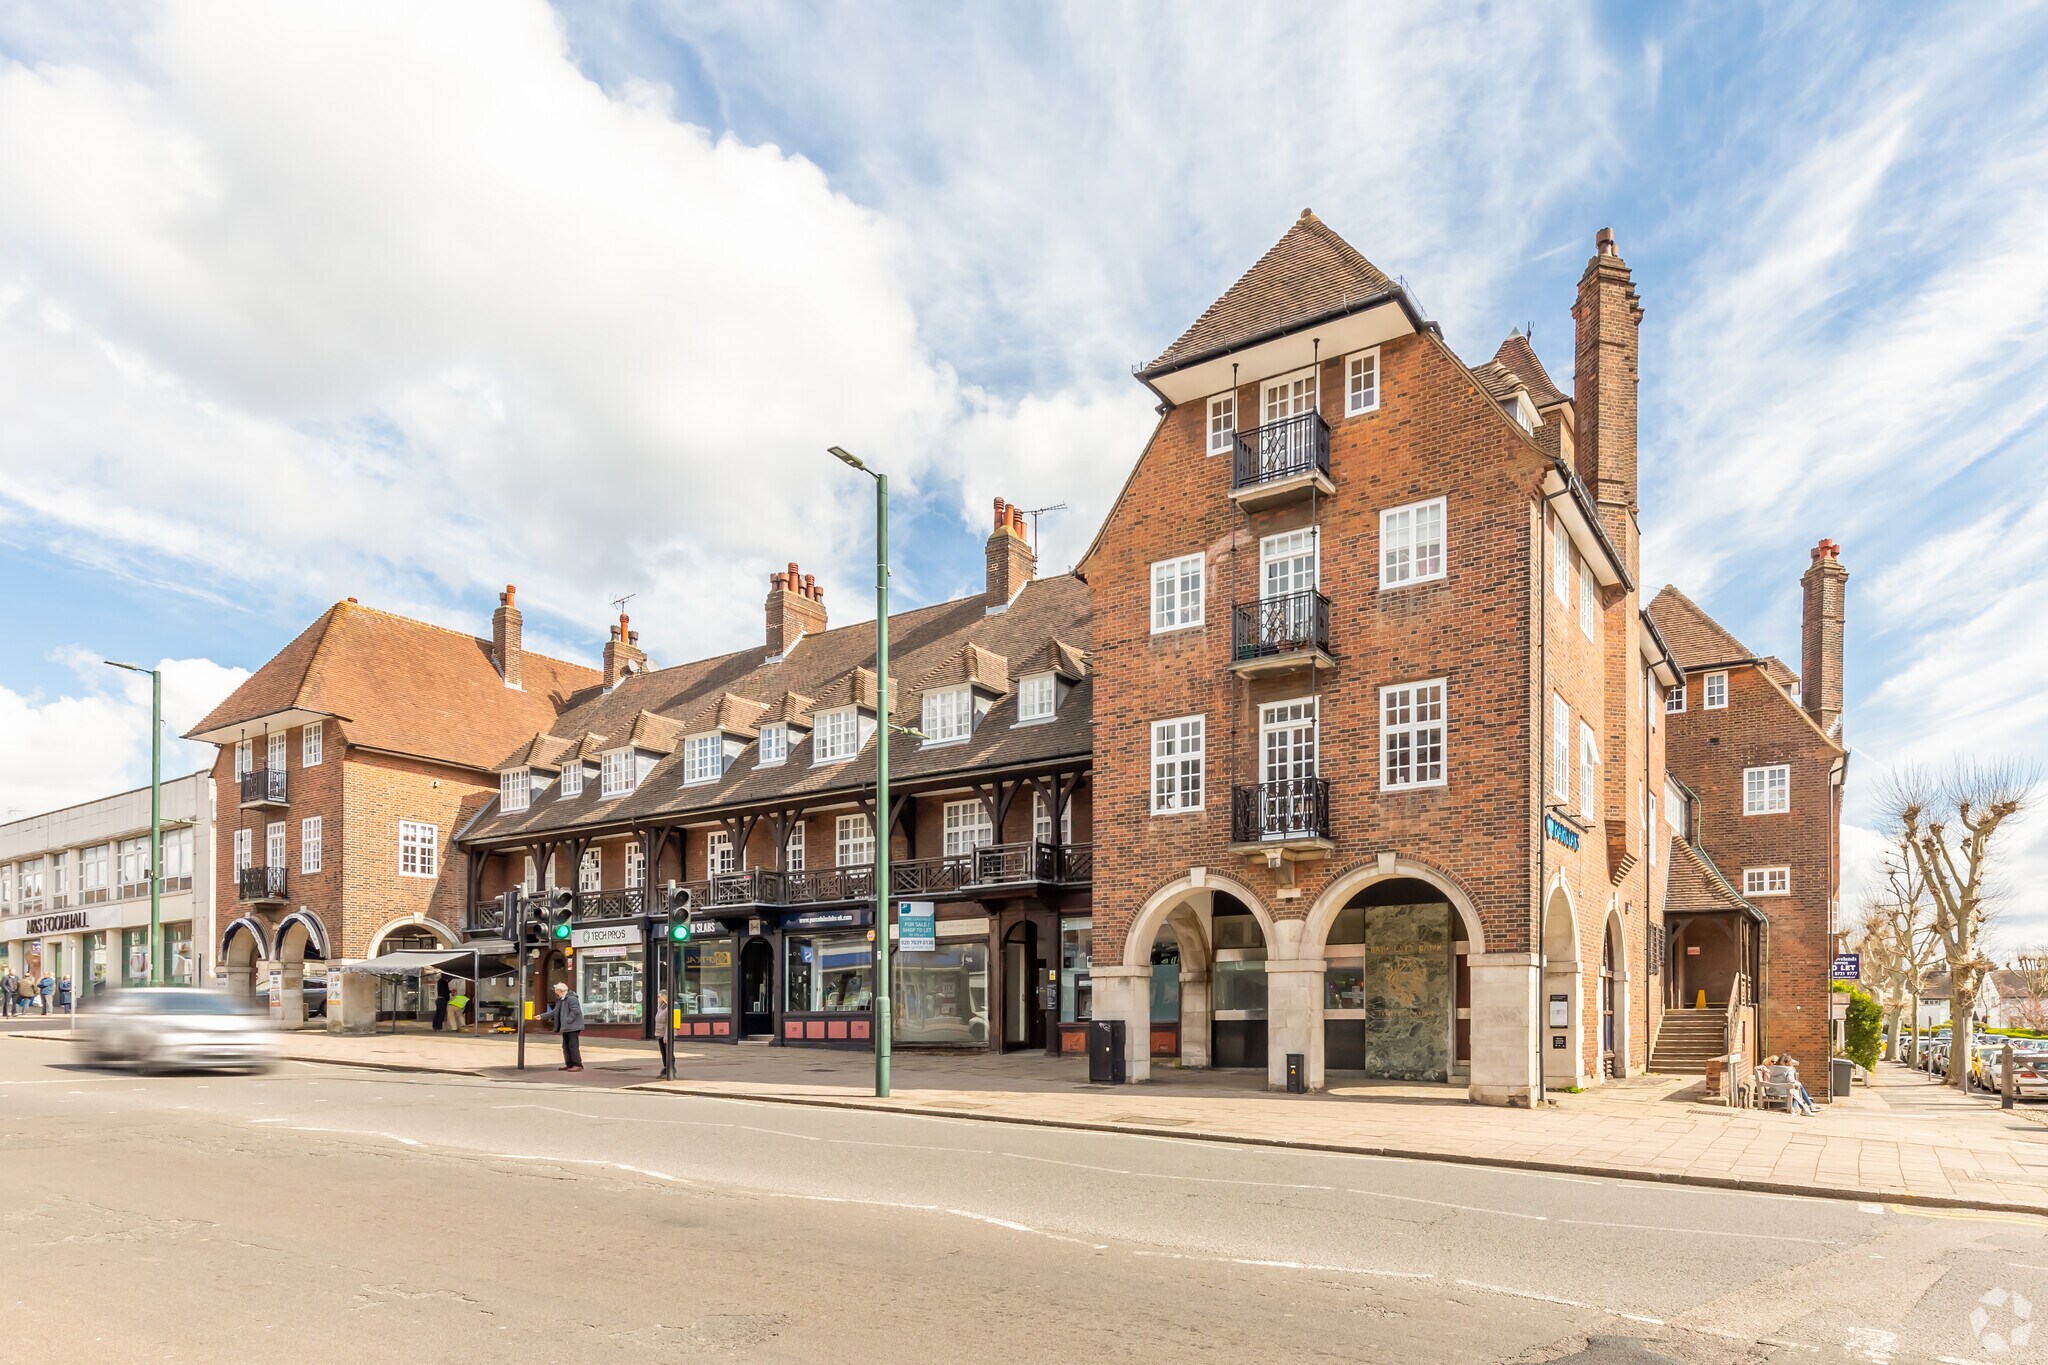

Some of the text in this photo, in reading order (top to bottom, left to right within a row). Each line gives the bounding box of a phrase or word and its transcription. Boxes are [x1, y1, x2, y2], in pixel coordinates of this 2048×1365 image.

[44, 911, 90, 932] FOODHALL
[696, 922, 716, 933] SLABS
[591, 929, 626, 941] TECH PROS
